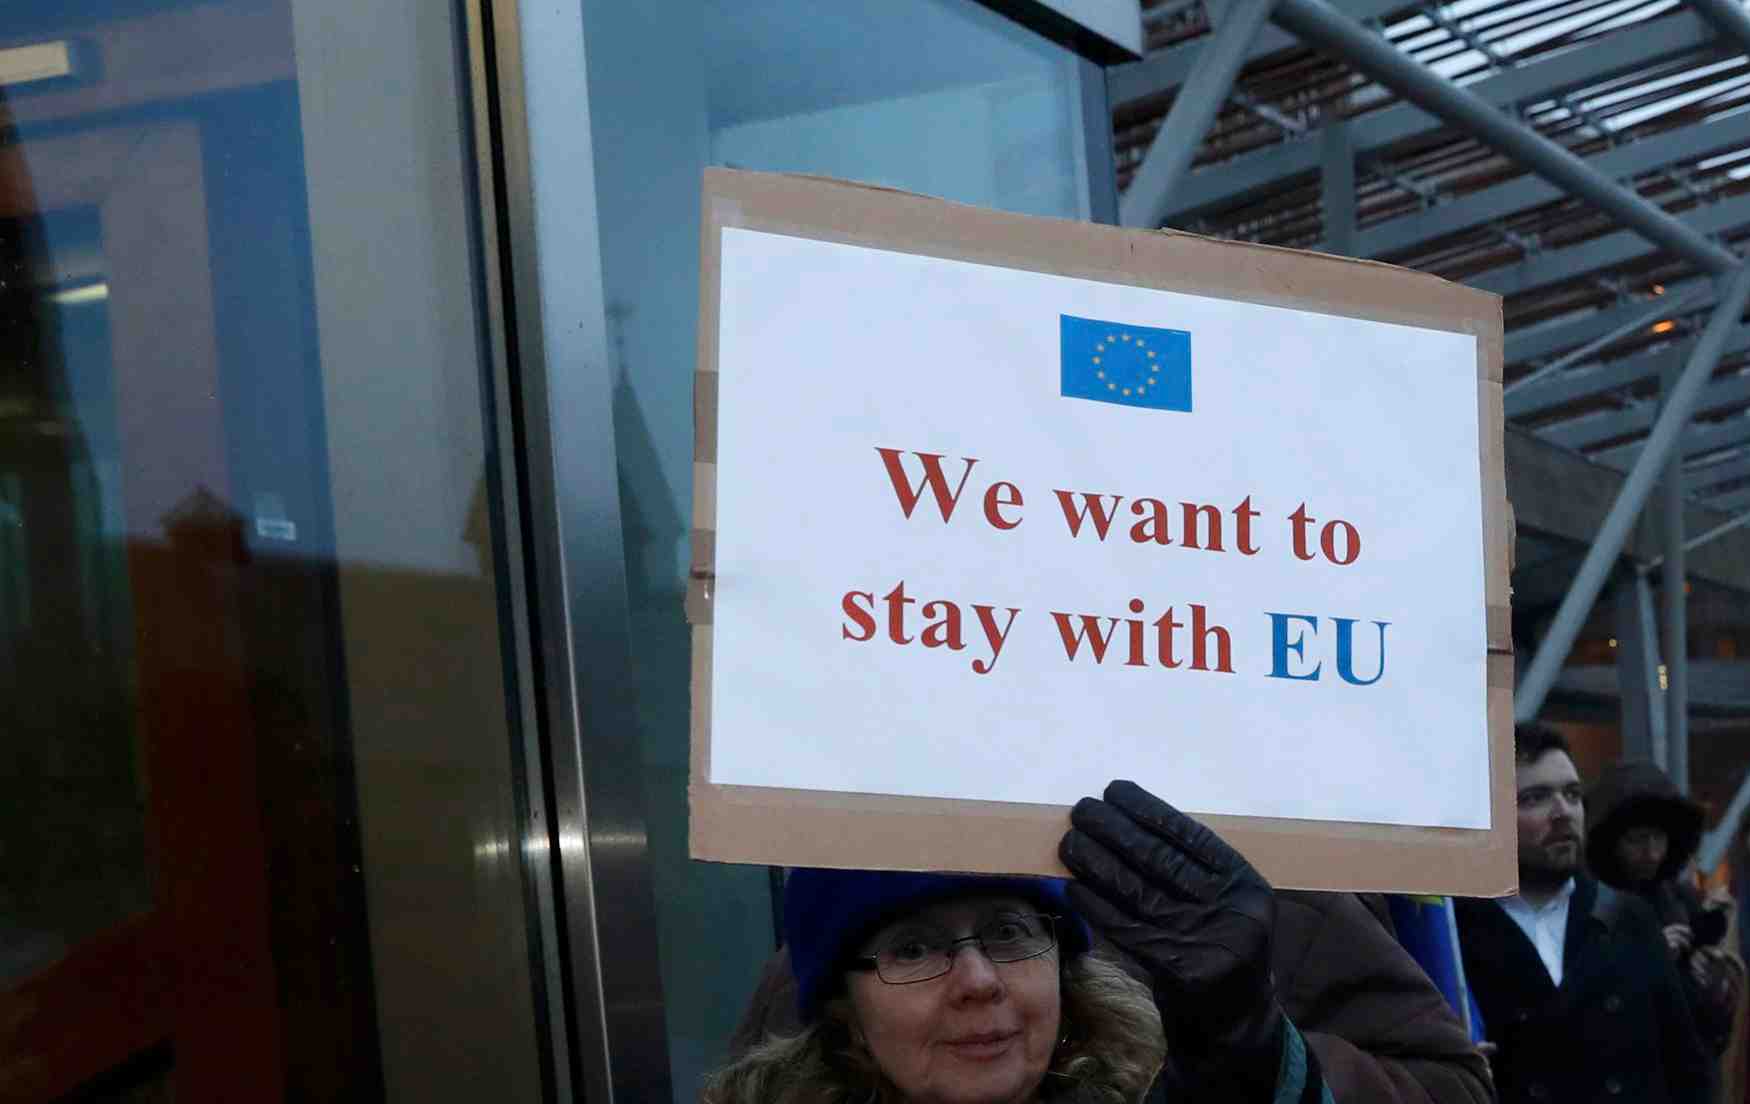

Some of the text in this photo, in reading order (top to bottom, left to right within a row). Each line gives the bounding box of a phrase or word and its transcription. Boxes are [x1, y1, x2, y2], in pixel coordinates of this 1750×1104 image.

[874, 446, 1361, 566] We want to
[841, 580, 1392, 686] stay with EU
